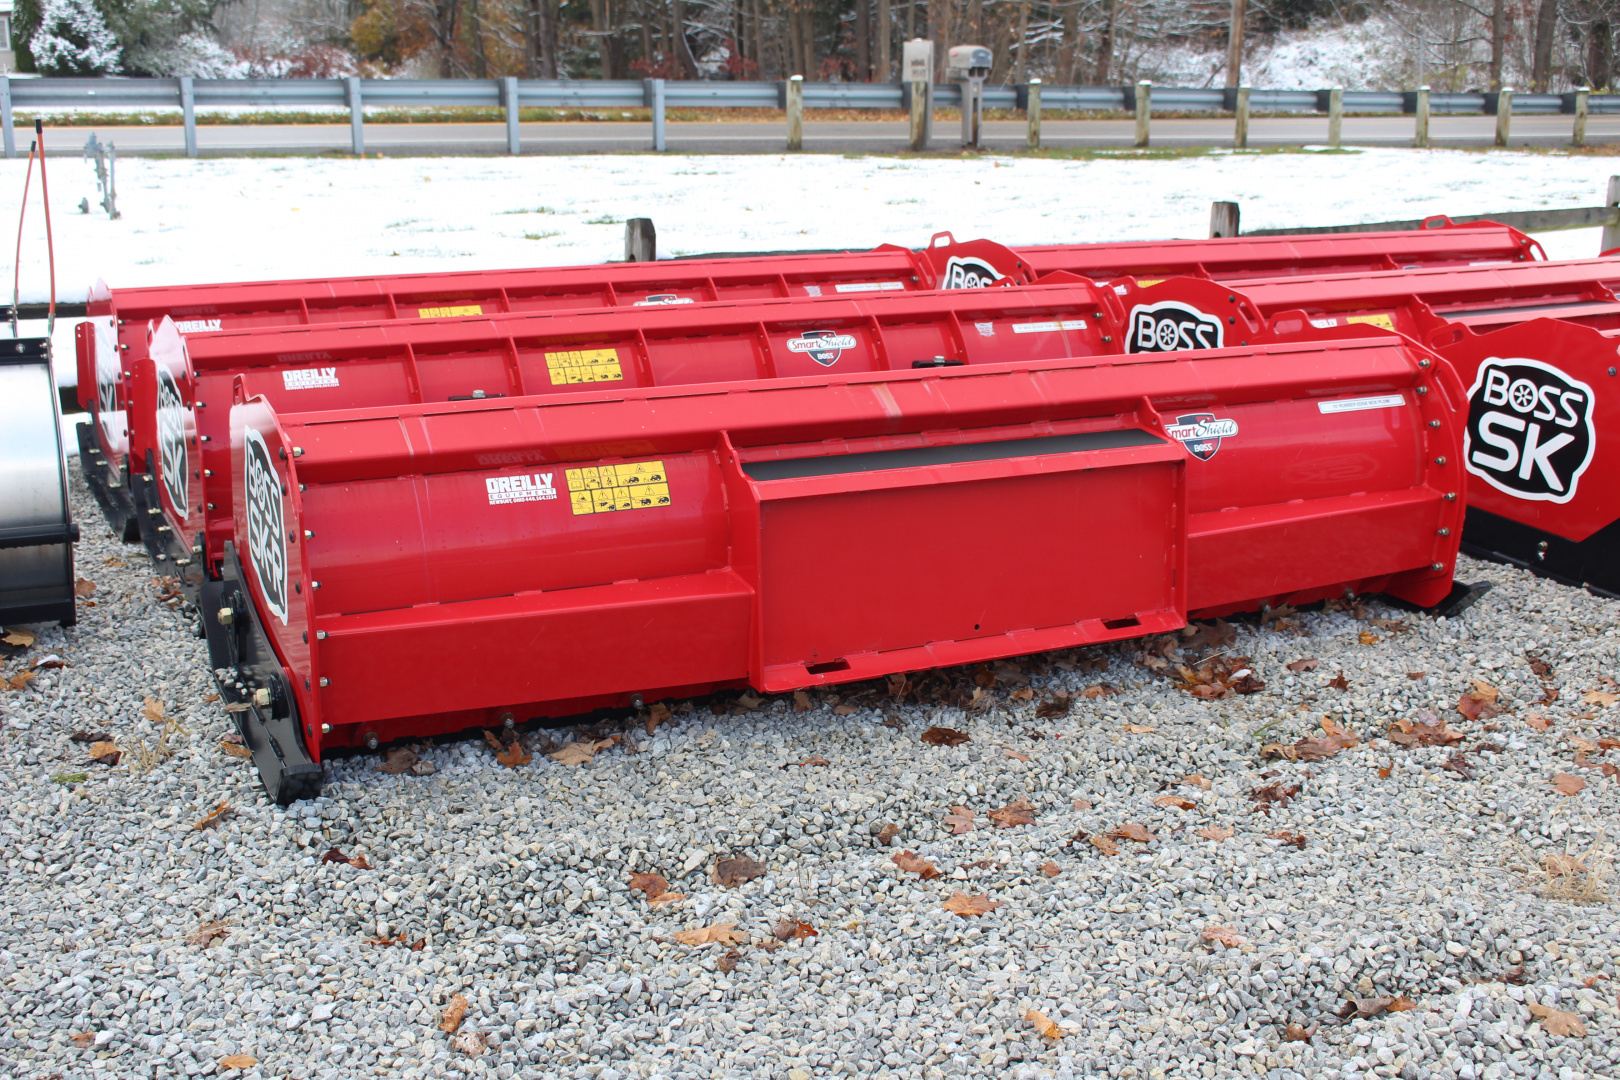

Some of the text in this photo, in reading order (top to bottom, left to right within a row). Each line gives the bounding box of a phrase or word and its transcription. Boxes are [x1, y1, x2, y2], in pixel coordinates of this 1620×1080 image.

[816, 352, 834, 360] BOSS
[1483, 368, 1583, 428] BOSS
[162, 420, 187, 508] SK
[1194, 443, 1213, 452] BOSS
[1472, 411, 1575, 492] SK
[248, 441, 280, 538] BOSS
[490, 488, 554, 500] EQUIPMENT
[250, 499, 285, 607] SK-R
